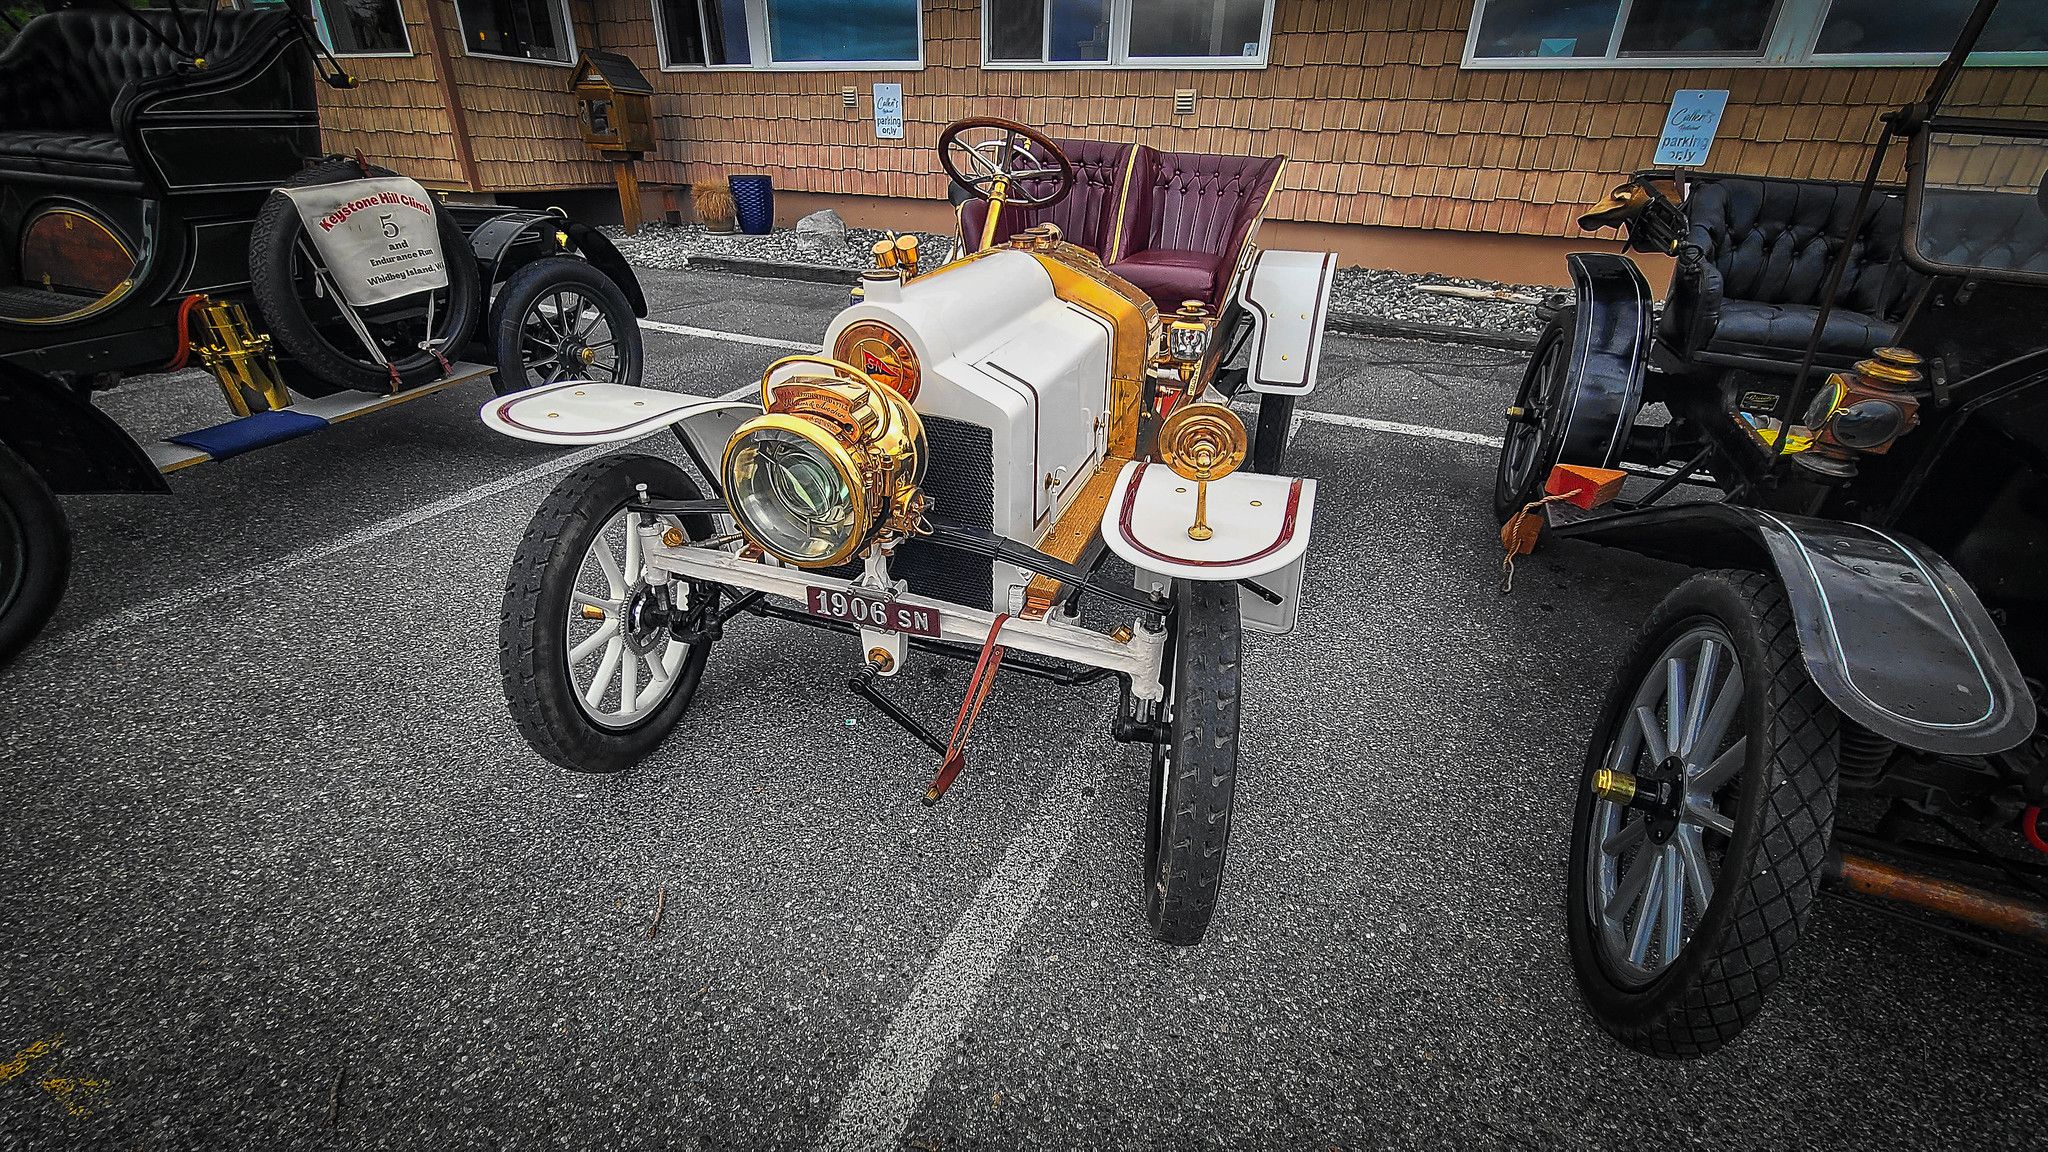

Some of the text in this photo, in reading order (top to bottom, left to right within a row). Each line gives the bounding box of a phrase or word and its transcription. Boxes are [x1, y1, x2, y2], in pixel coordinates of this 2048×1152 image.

[877, 116, 901, 128] parking
[1661, 135, 1709, 150] parking
[319, 192, 431, 233] Keystone Hill Climb
[380, 213, 400, 239] 5
[388, 239, 409, 251] and
[369, 248, 434, 267] Endurance Run
[366, 273, 407, 286] Whidbey
[406, 264, 437, 277] Island,
[867, 358, 882, 373] SN
[815, 590, 930, 632] 1906 SN
